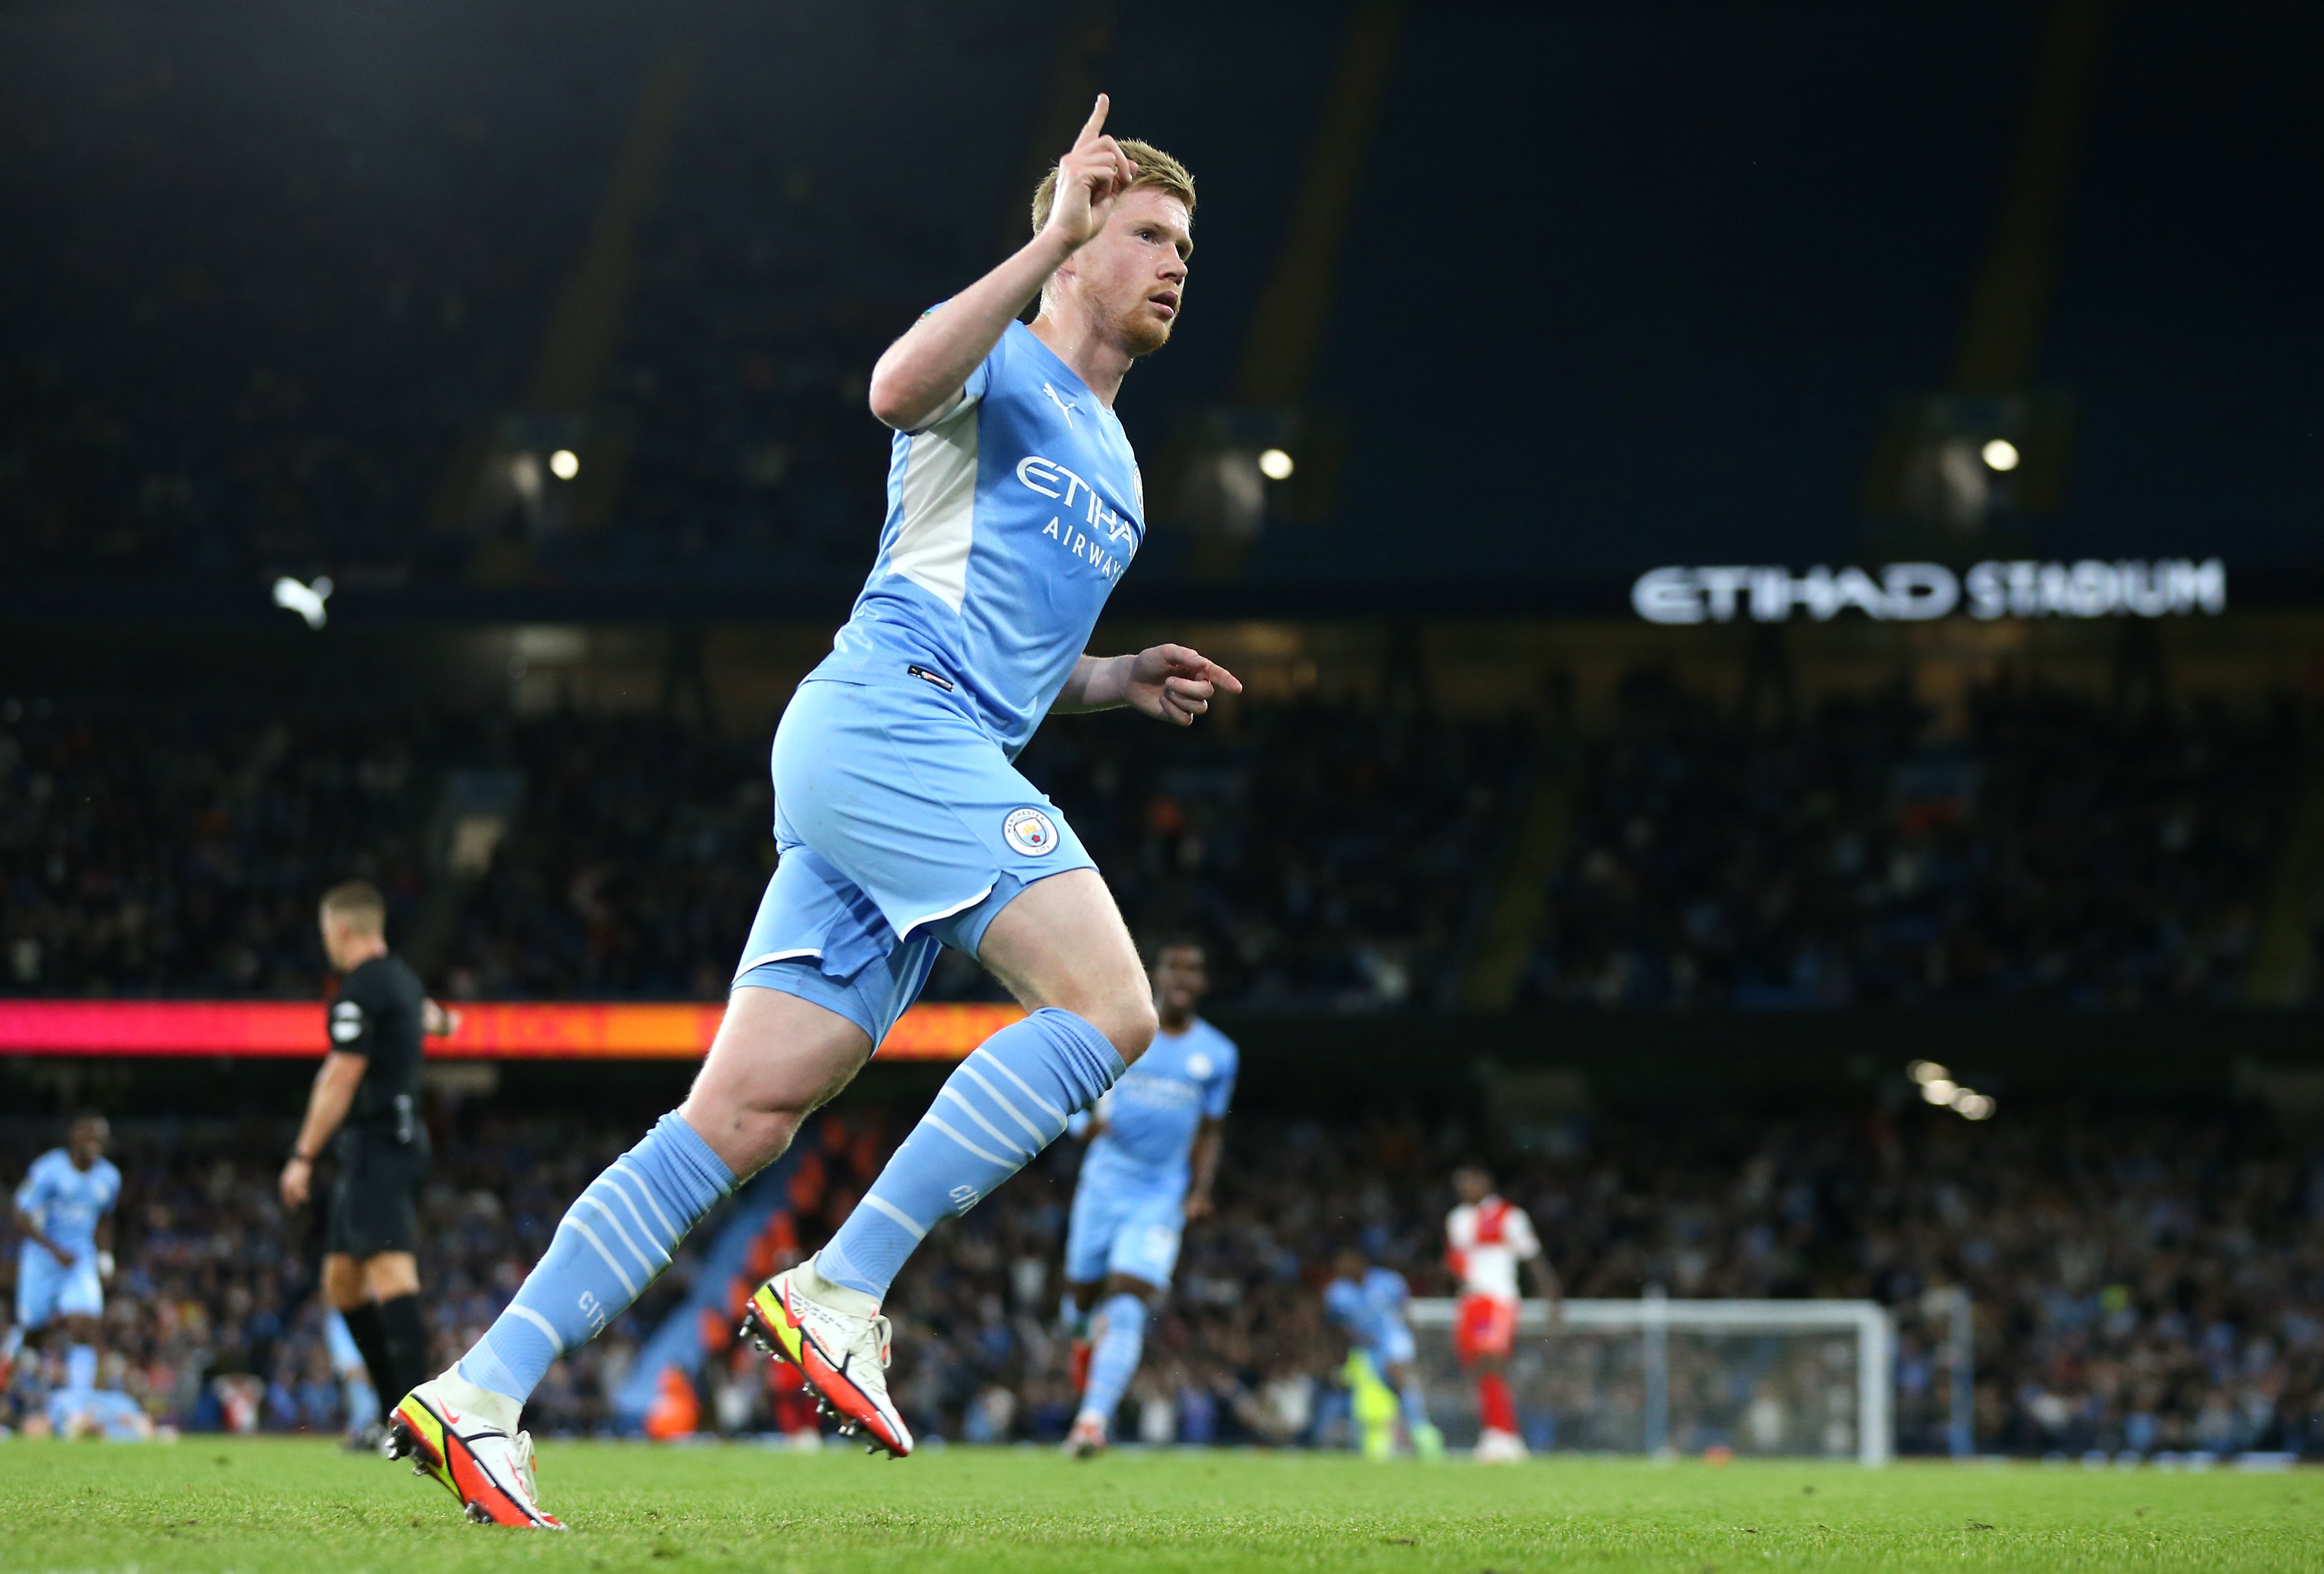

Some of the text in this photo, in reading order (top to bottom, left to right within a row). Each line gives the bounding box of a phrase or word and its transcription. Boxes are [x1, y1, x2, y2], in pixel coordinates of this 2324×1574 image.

[1016, 455, 1138, 560] ETIHA
[1632, 558, 2226, 625] ETIHAD STADIUM
[1007, 811, 1045, 833] MANCHESTER
[1036, 844, 1050, 854] CITY
